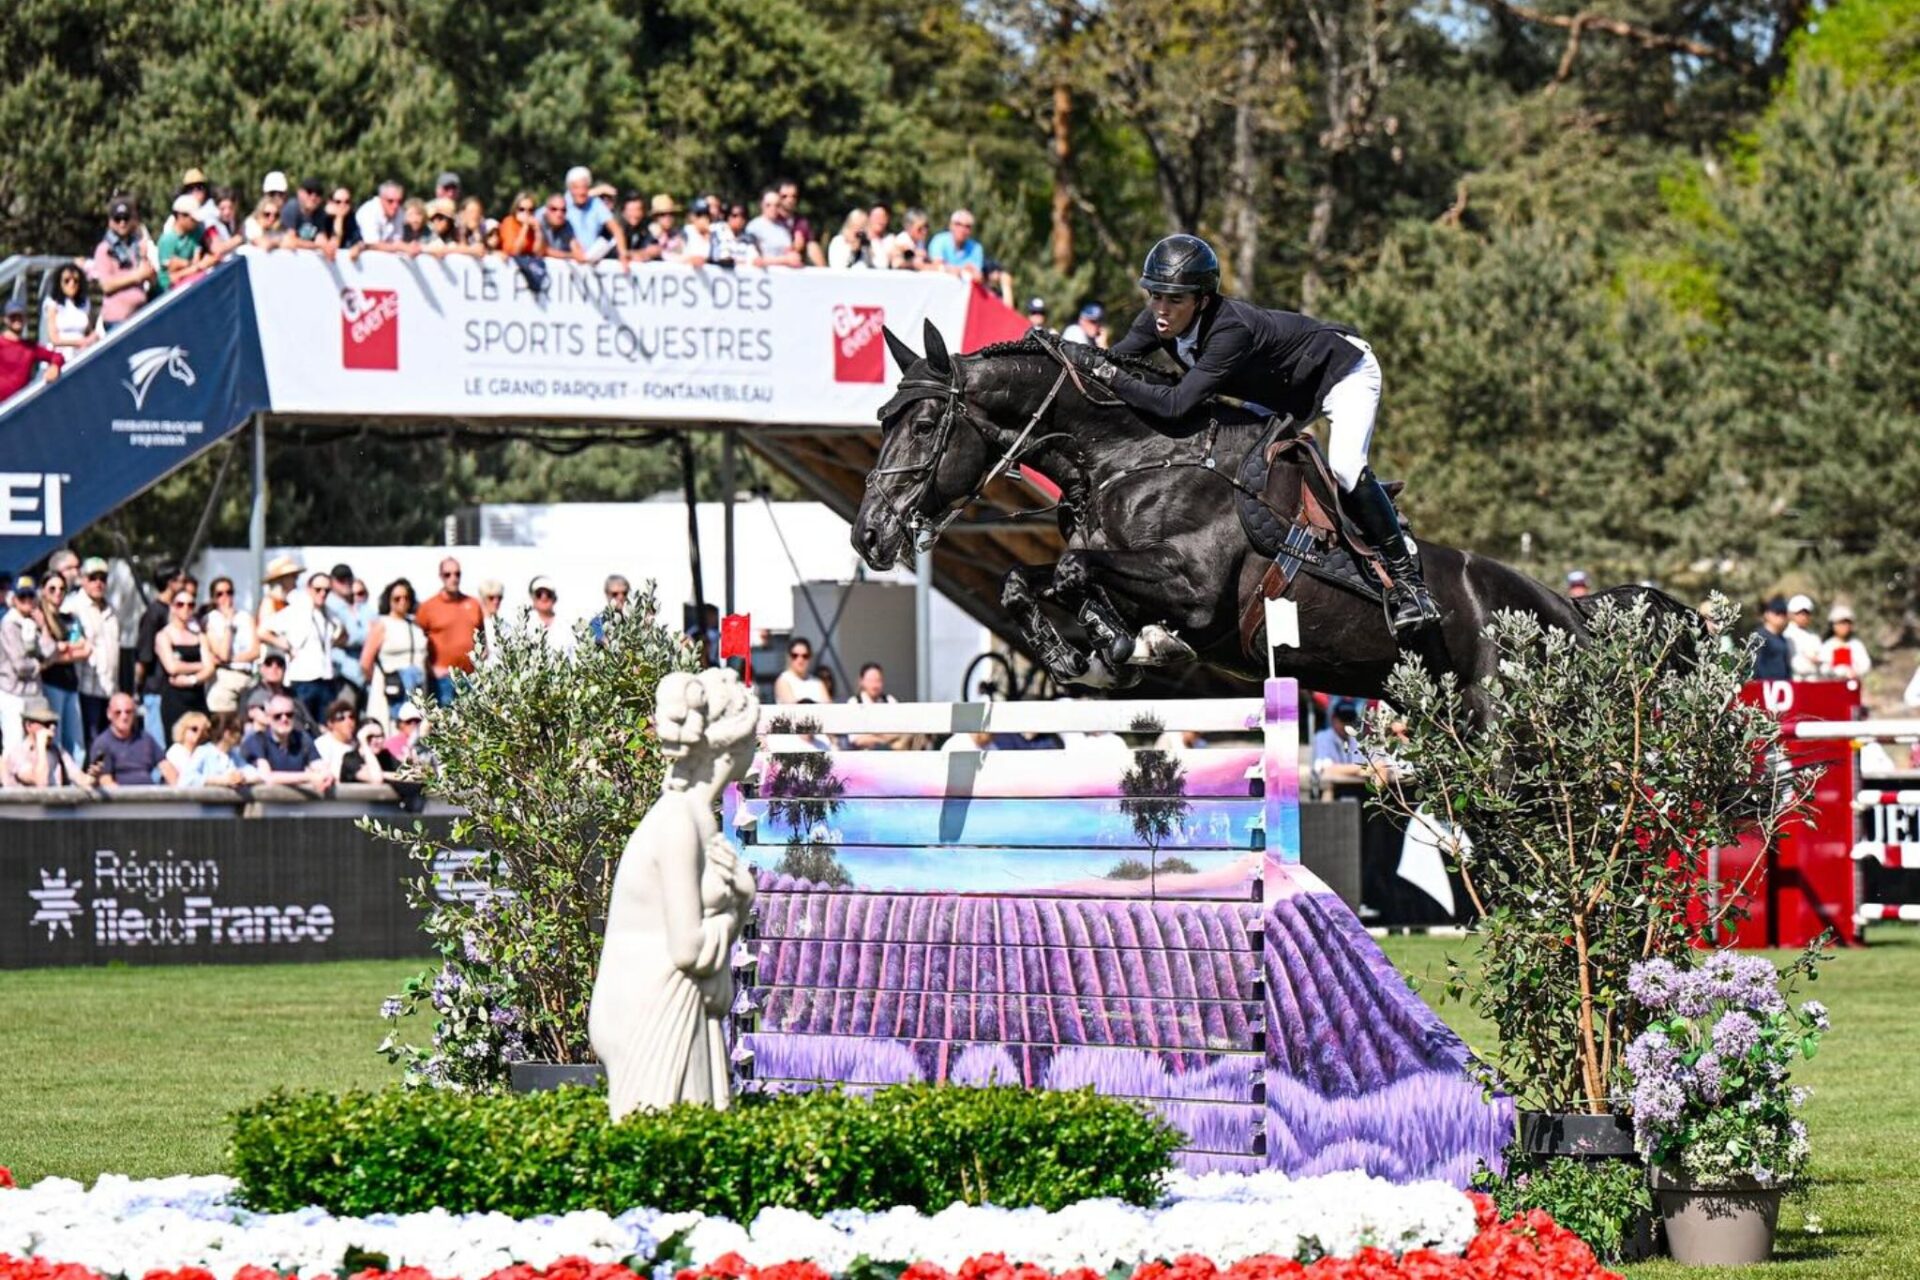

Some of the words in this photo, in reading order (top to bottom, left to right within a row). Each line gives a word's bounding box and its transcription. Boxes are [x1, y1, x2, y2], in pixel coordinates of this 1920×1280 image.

[464, 268, 499, 301] LE
[711, 276, 774, 311] DES
[464, 319, 585, 356] SPORTS
[464, 377, 484, 396] LE
[488, 378, 548, 398] GRAND
[552, 380, 628, 401] PARQUET
[643, 381, 774, 403] FONTAINEBLEAU
[95, 849, 219, 902] Région
